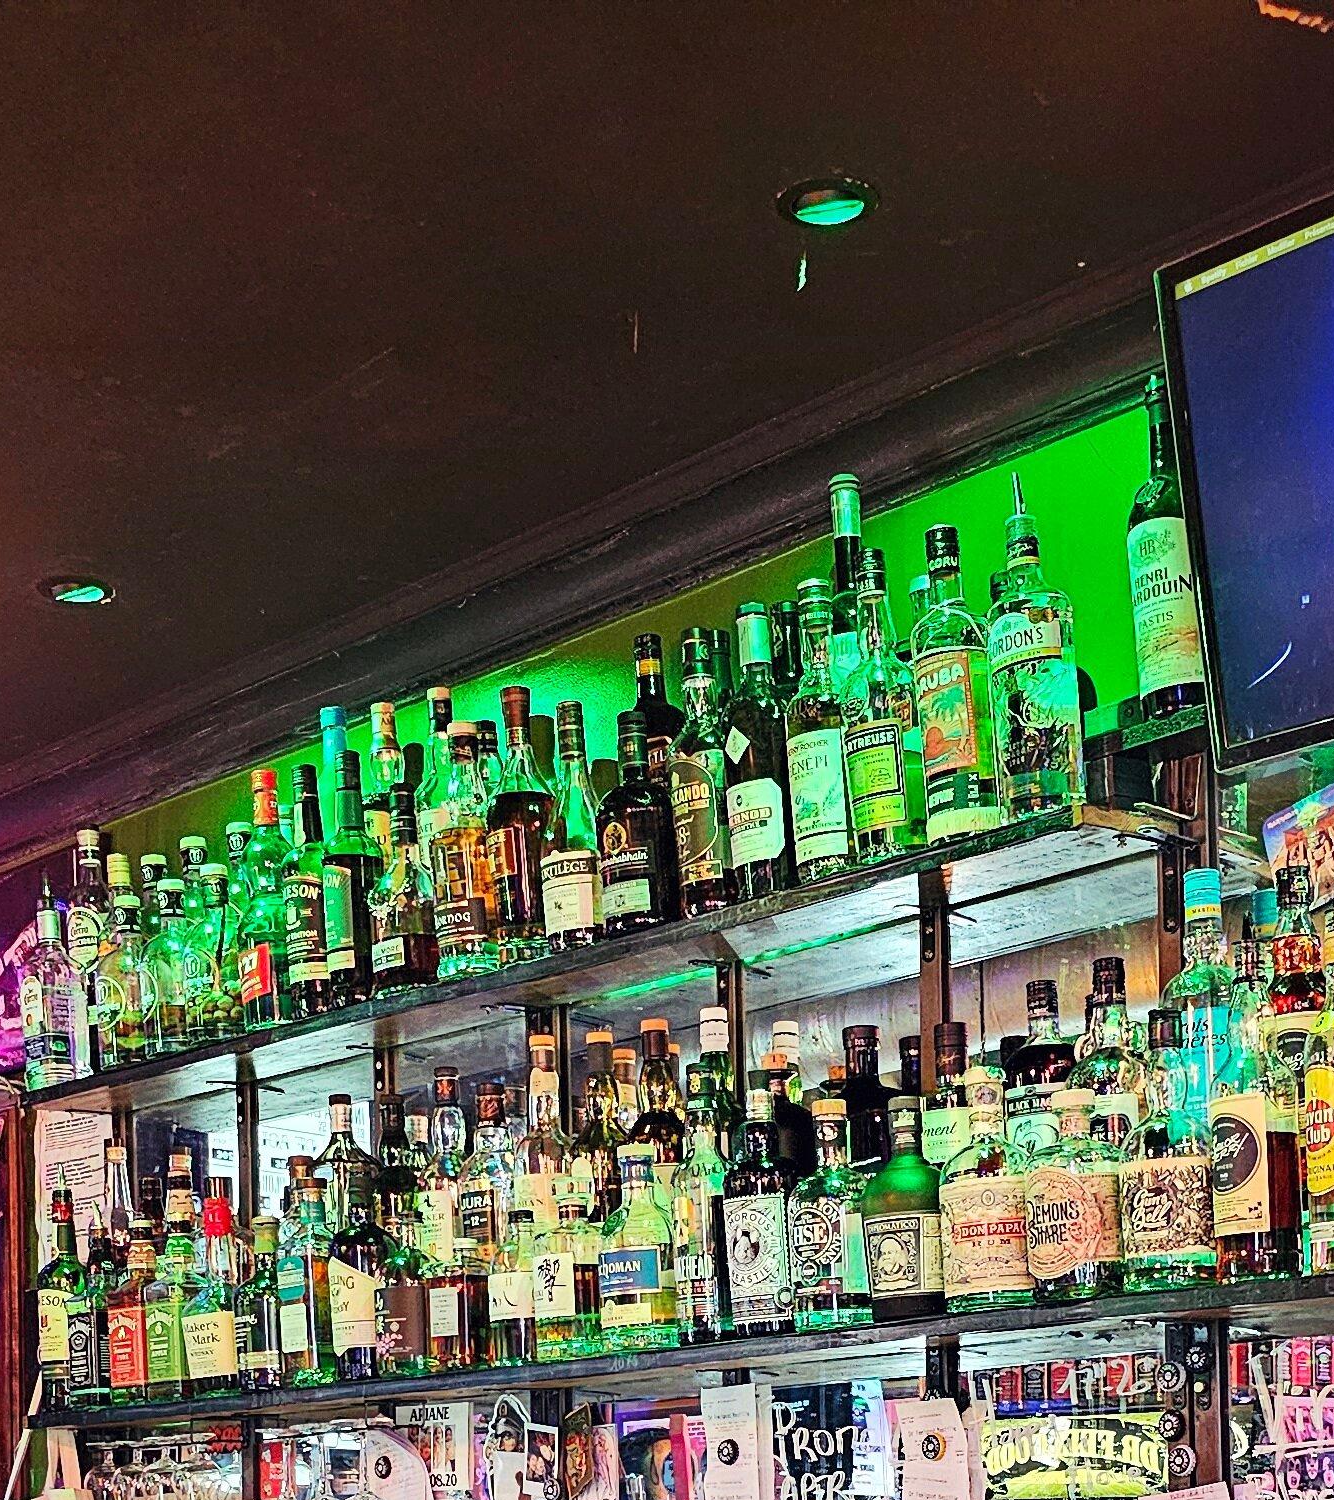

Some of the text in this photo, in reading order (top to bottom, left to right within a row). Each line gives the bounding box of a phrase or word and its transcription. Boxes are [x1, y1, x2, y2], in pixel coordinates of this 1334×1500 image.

[1130, 574, 1193, 606] ARDOUIN
[1133, 568, 1169, 592] HENRI
[1137, 610, 1174, 630] PASTIS
[462, 1193, 492, 1210] JURA
[794, 1224, 827, 1245] HSE
[961, 1220, 1022, 1236] DON PAPA
[1028, 1224, 1068, 1250] SHARE
[971, 1238, 1011, 1247] RUM
[192, 1334, 220, 1344] Mark
